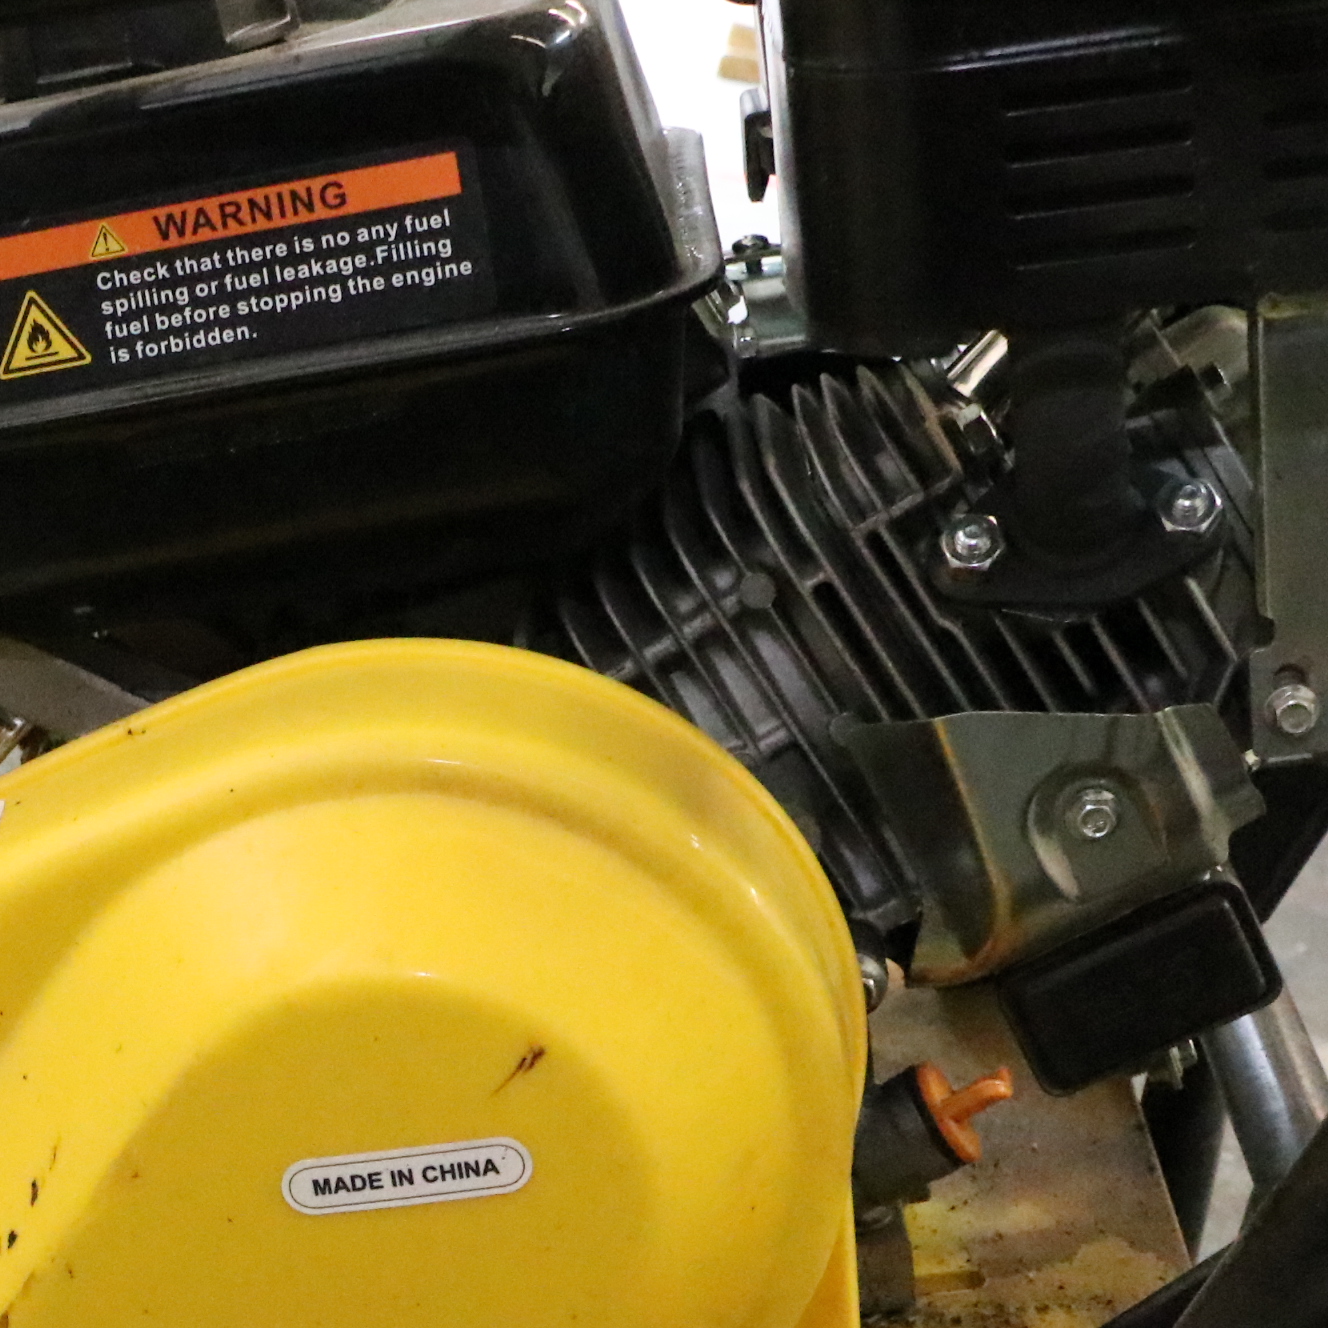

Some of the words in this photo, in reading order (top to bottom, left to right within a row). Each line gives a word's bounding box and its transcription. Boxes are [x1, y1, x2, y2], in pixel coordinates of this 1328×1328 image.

[152, 180, 347, 241] WARNING
[96, 261, 171, 290] Check
[174, 251, 222, 277] that
[226, 242, 288, 267] there
[293, 235, 315, 254] is
[321, 231, 350, 249] no
[356, 221, 399, 243] any
[404, 208, 451, 234] fuel
[100, 285, 189, 317] spilling
[195, 280, 219, 298] or
[224, 267, 269, 293] fuel
[105, 315, 150, 340] fuel
[155, 304, 231, 330] before
[237, 283, 342, 313] stopping
[347, 275, 385, 296] the
[391, 260, 473, 287] engine
[109, 346, 130, 364] is
[135, 325, 258, 359] forbidden.
[312, 1171, 384, 1196] MADE
[390, 1167, 415, 1188] IN
[421, 1158, 500, 1184] CHINA
